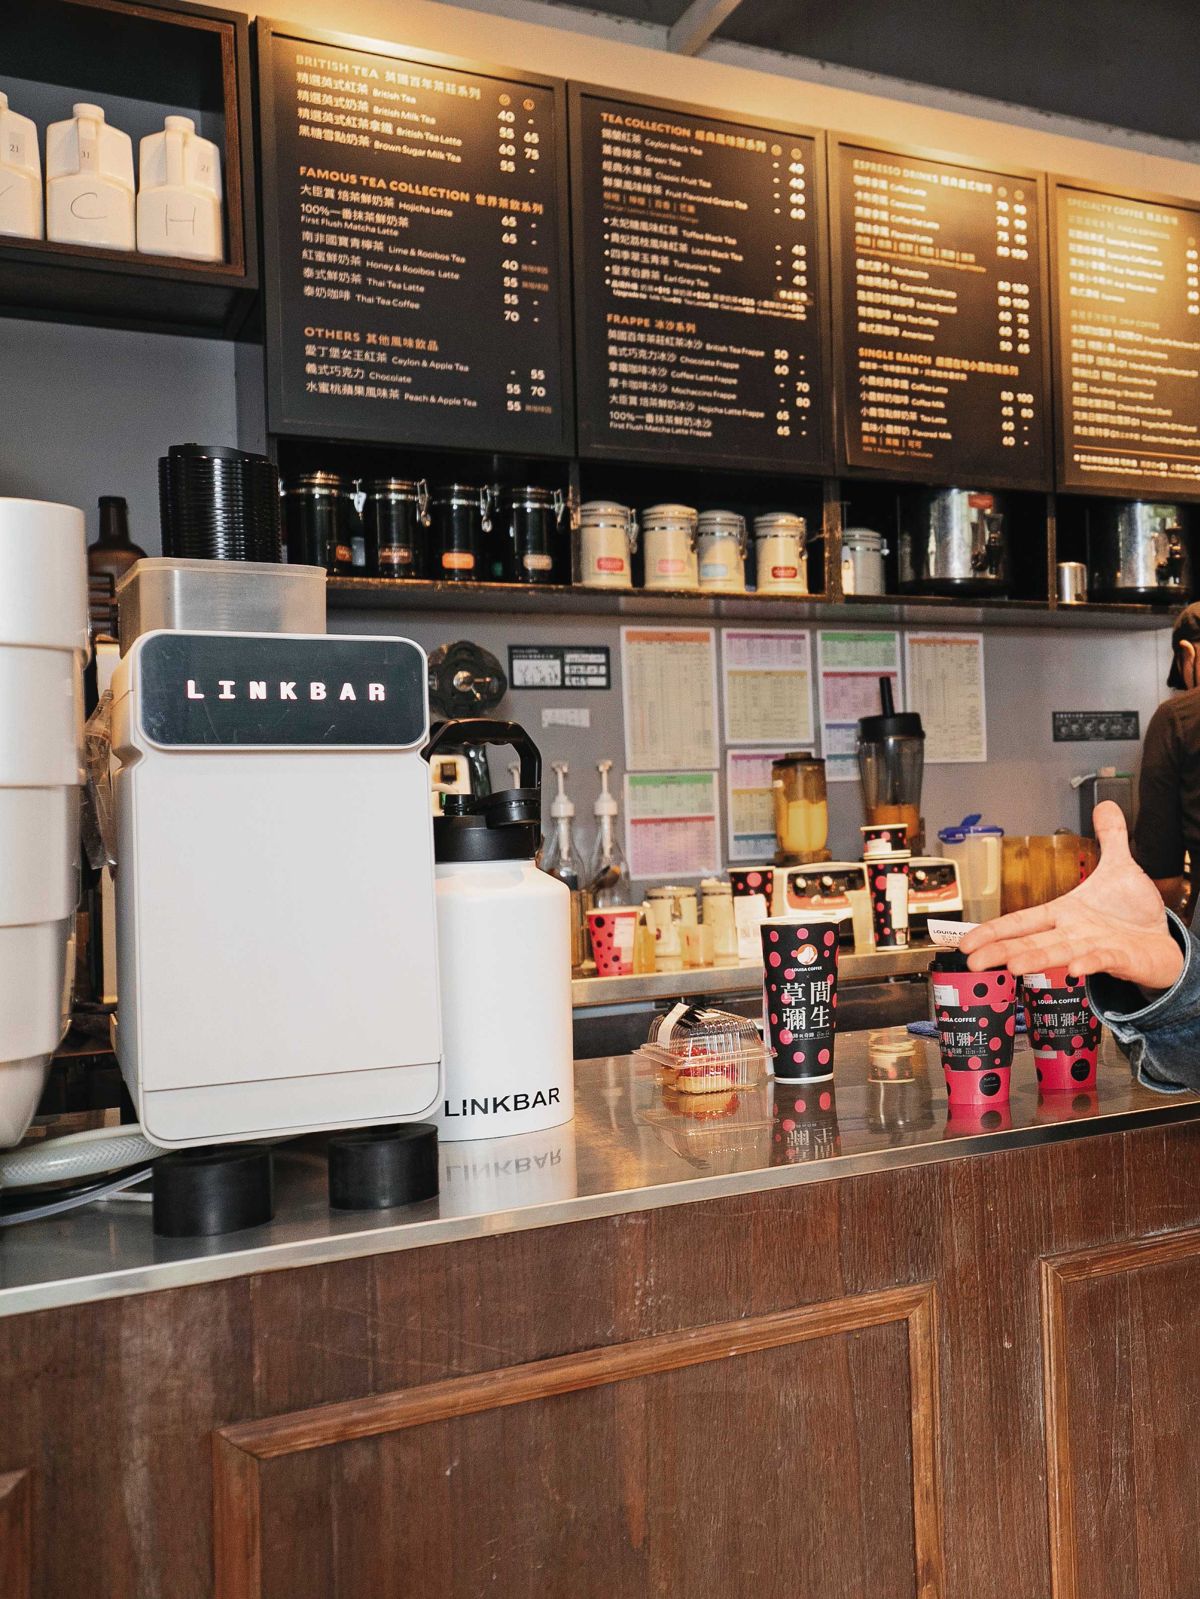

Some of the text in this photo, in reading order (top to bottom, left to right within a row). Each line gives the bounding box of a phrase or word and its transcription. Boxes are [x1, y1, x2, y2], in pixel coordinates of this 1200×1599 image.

[296, 54, 379, 80] BRITISH TEA
[400, 93, 416, 105] Tea
[420, 114, 436, 125] Tea
[497, 110, 516, 123] 40
[601, 112, 691, 138] TEA COLLECTION
[424, 131, 438, 142] Tea
[499, 127, 539, 144] 55 65
[446, 152, 462, 163] Tea
[498, 143, 540, 160] 60 75
[500, 160, 516, 173] 55
[300, 166, 357, 185] FAMOUS
[360, 175, 386, 190] TEA
[389, 180, 470, 203] COLLECTION
[70, 192, 108, 219] C
[165, 203, 196, 236] H
[501, 216, 517, 228] 65
[502, 233, 517, 245] 65
[450, 254, 466, 264] Tea
[502, 260, 518, 272] 40
[503, 276, 518, 288] 55
[367, 277, 385, 288] Thai
[387, 279, 401, 290] Tea
[504, 294, 519, 305] 55
[355, 293, 374, 304] Thai
[376, 295, 391, 306] Tea
[503, 311, 520, 322] 70
[606, 313, 650, 328] FRAPPE
[304, 327, 360, 342] OTHERS
[774, 349, 789, 361] 50
[858, 347, 894, 361] SINGLE
[454, 363, 469, 373] Tea
[530, 369, 545, 381] 55
[774, 365, 789, 376] 60
[369, 371, 412, 384] Chocolate
[506, 383, 521, 395] 55
[530, 386, 546, 398] 70
[796, 382, 810, 393] 70
[462, 398, 477, 408] Tea
[506, 400, 521, 412] 55
[796, 397, 811, 409] 80
[776, 410, 790, 422] 65
[777, 426, 791, 437] 65
[186, 680, 387, 701] LINKBAR
[780, 981, 831, 1006] 草間
[782, 1005, 830, 1031] 彌生
[940, 1031, 988, 1047] 間彌生
[445, 1088, 560, 1117] LINKBAR
